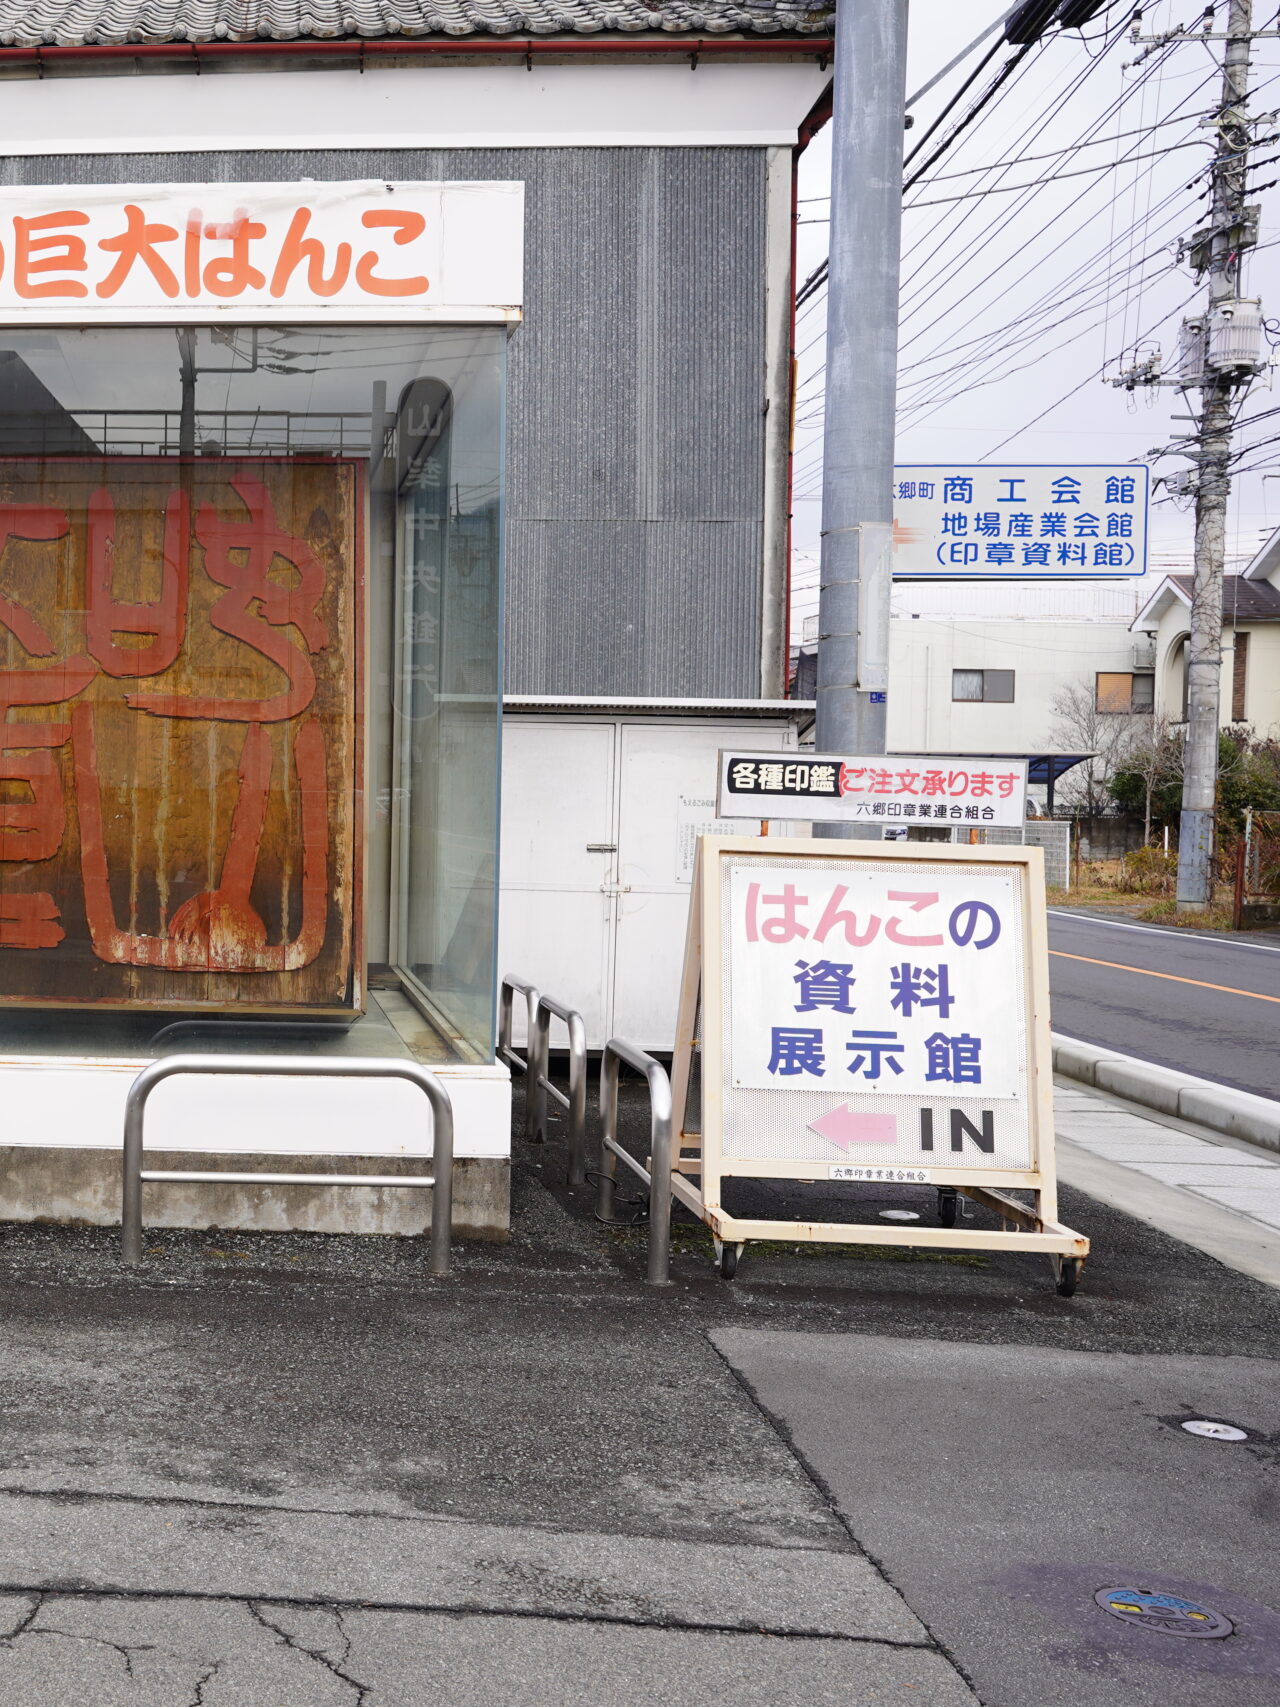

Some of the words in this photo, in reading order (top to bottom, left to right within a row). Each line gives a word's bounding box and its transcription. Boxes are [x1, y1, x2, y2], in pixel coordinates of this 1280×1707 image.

[893, 481, 936, 499] 郷町
[942, 475, 1136, 504] 商工会館
[941, 511, 1134, 538] 地場産業会館
[936, 541, 1136, 566] (印章資料館)
[732, 762, 836, 792] 各種印鑑
[841, 767, 1021, 798] ご注文承ります
[856, 802, 995, 820] 六郷印章業連合組合
[744, 882, 1002, 950] はんこの
[792, 959, 956, 1019] 資料
[766, 1027, 982, 1085] 展示館
[920, 1107, 995, 1154] IN
